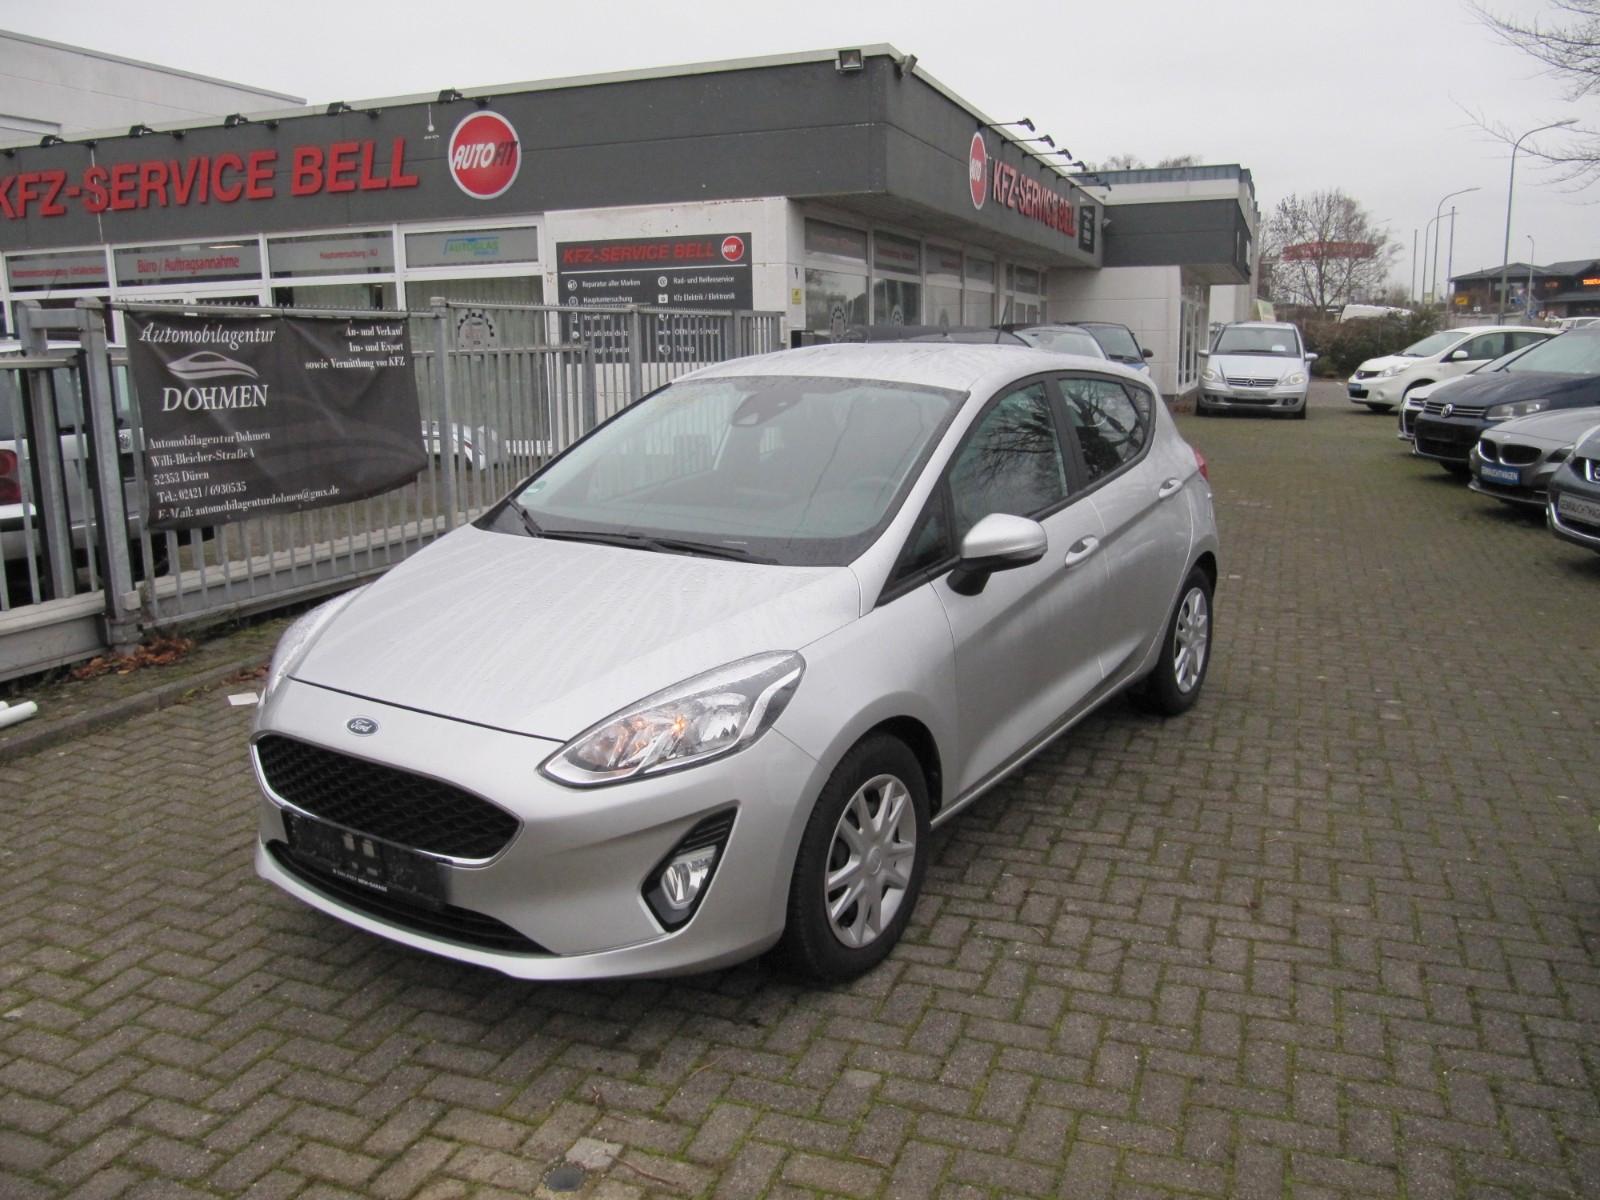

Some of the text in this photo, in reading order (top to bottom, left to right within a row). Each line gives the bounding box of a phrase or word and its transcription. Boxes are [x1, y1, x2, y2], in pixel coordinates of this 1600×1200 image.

[0, 139, 420, 220] KFZ-SERVICE BELL
[993, 159, 1058, 228] KFZ-SERVICE
[1057, 197, 1077, 238] BELL
[563, 240, 715, 265] KFZ-SERVICE BELL
[140, 321, 277, 351] Automobilagentur
[361, 325, 376, 337] und
[376, 324, 404, 337] Verkauf
[365, 341, 380, 353] und
[380, 341, 405, 355] Export
[305, 358, 330, 370] sowie
[330, 357, 376, 371] Vermittlung
[388, 356, 406, 368] KFZ
[162, 384, 270, 412] DOHMEN
[150, 430, 271, 449] Automobilagentur Dohmen
[150, 448, 248, 468] Willi-Bleicher-Straße
[153, 470, 210, 487] 52353 Düren
[210, 481, 248, 497] 6930535
[350, 719, 373, 732] Ford
